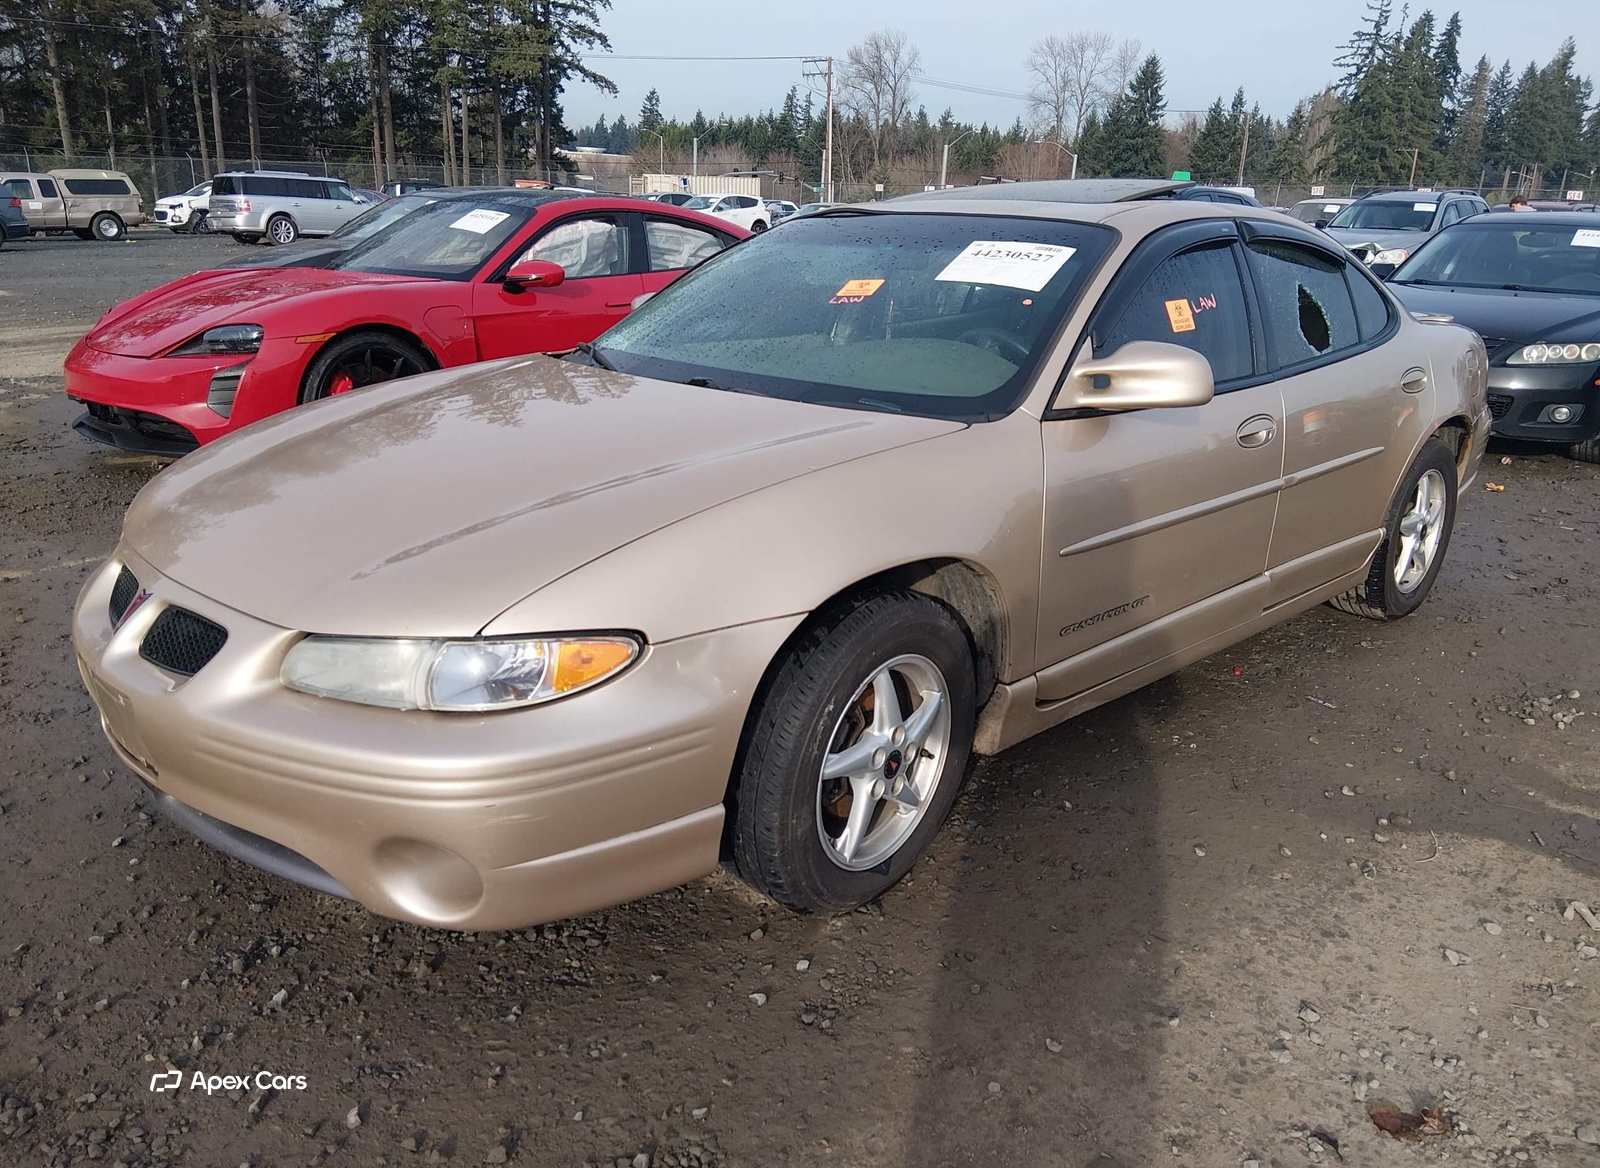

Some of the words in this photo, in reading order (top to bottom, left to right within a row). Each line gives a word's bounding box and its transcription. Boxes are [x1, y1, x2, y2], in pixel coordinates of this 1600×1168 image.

[1568, 192, 1582, 200] SF4
[971, 249, 1055, 263] 44230527
[828, 295, 865, 305] LAW
[1191, 293, 1217, 314] LAW
